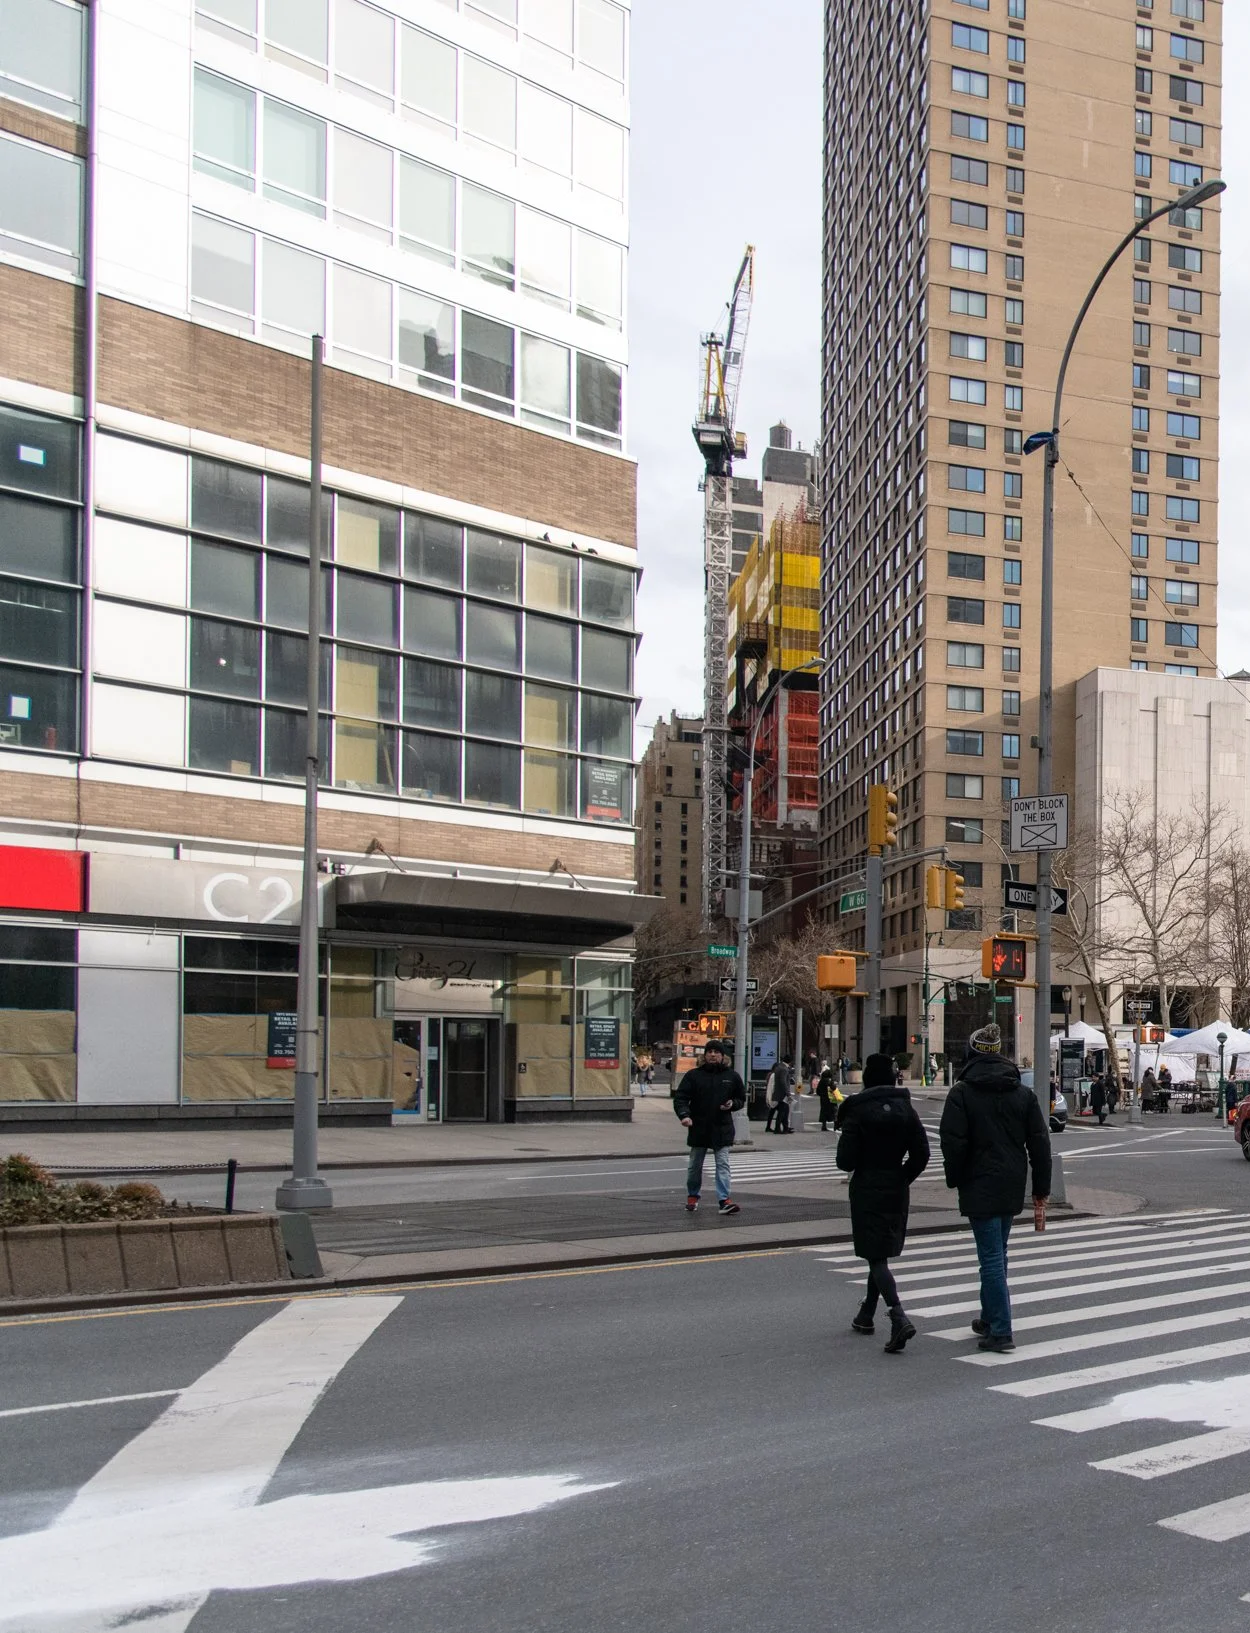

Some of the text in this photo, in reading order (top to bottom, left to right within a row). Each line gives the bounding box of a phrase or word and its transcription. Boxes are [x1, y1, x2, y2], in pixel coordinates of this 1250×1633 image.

[1014, 799, 1064, 812] DON'T BLOCK
[1023, 811, 1055, 823] THE BOX
[848, 893, 865, 907] W 66
[1014, 890, 1032, 903] ONE
[711, 946, 735, 956] Broadway
[975, 1043, 1000, 1053] MICHIG
